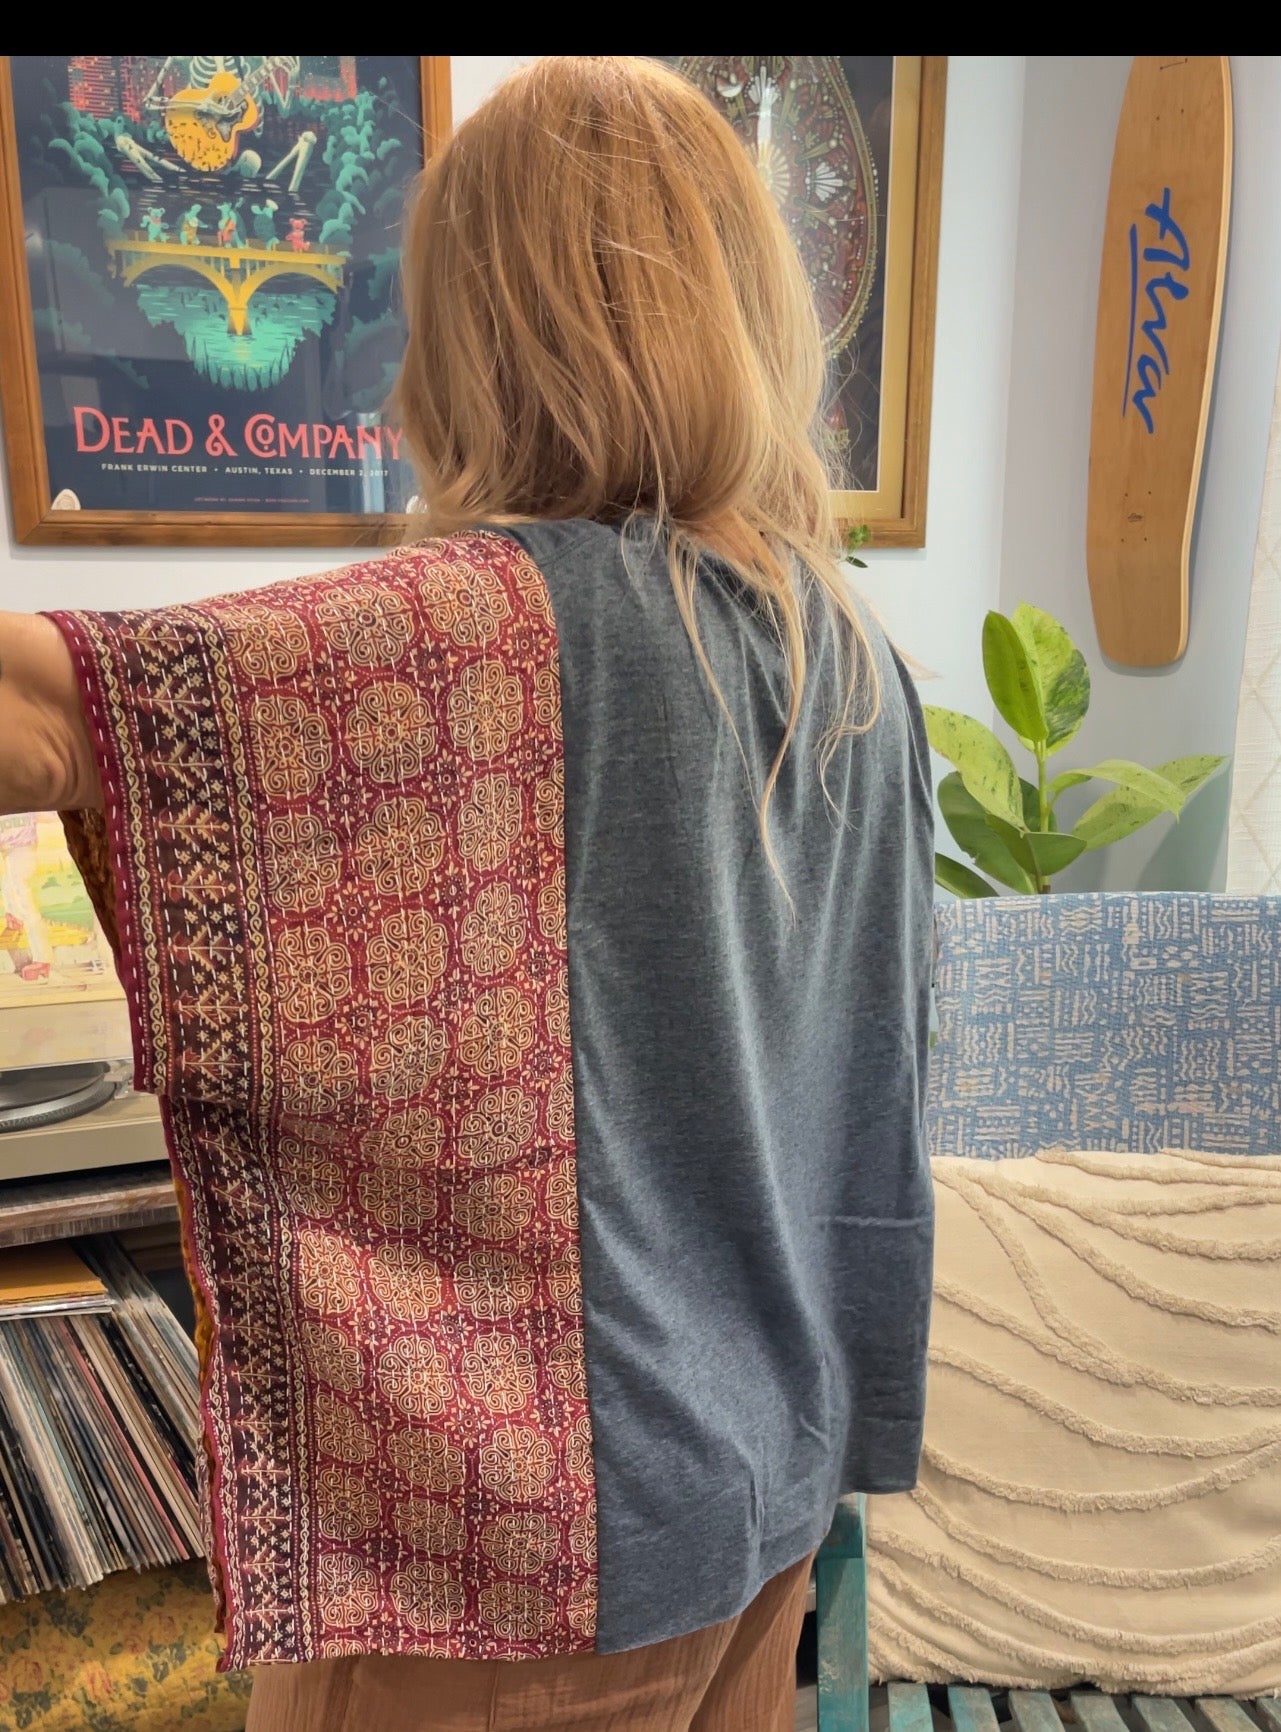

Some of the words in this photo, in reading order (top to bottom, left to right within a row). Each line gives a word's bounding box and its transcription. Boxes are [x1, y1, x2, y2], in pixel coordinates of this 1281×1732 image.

[1131, 187, 1190, 433] Alva
[74, 406, 194, 455] DEAD
[205, 414, 238, 457] &
[244, 413, 402, 460] COMPANY
[101, 463, 134, 472] FRANK
[137, 464, 169, 473] ERWIN
[171, 466, 208, 474] CENTER
[225, 466, 261, 475] AUSTIN,
[265, 467, 293, 475] TEXAS
[309, 468, 356, 477] DECEMBER
